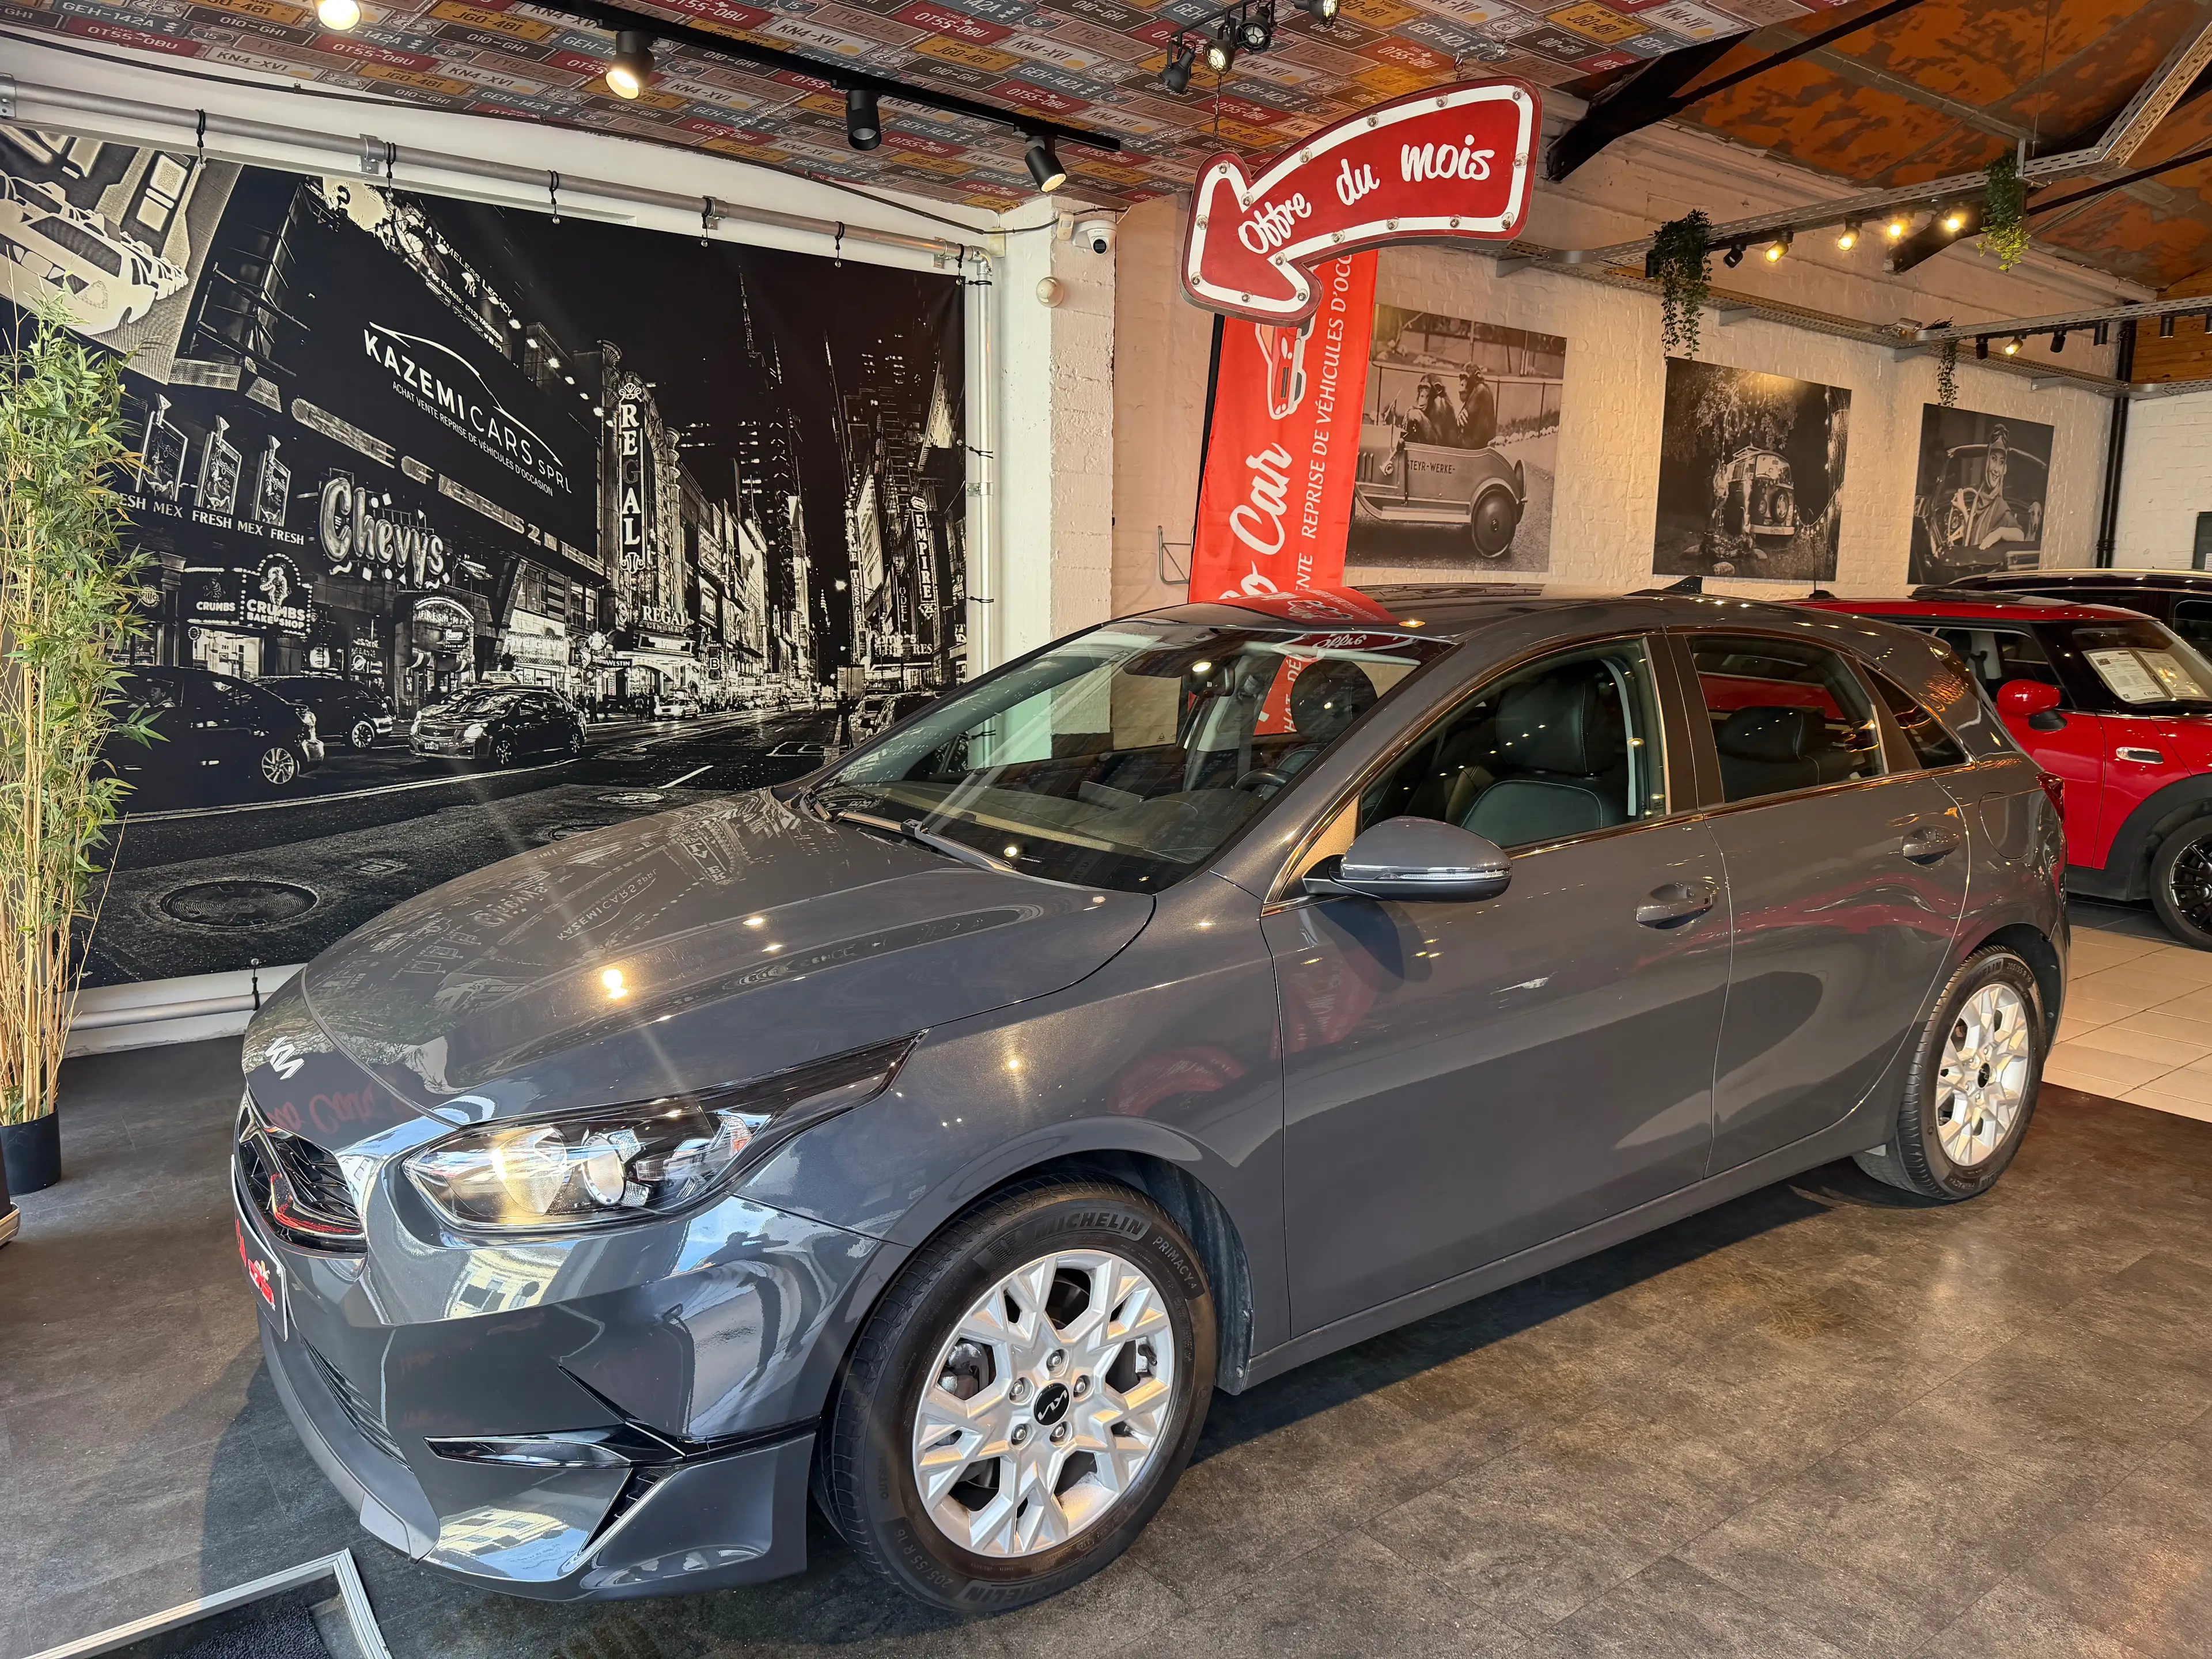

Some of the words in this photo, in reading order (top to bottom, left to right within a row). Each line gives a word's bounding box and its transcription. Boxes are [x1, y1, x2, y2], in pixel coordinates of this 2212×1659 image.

[62, 2, 154, 28] GEH-142A
[1035, 16, 1044, 26] 15
[1020, 66, 1084, 90] GEH-142A
[481, 91, 550, 111] GEH-142A
[1105, 94, 1117, 103] 15
[1309, 105, 1319, 113] 15
[1238, 192, 1312, 255] Offre
[1336, 158, 1380, 206] du
[1402, 134, 1495, 182] mois
[1315, 317, 1344, 424] VÉHICULES
[364, 329, 464, 420] KAZEMI
[471, 406, 533, 465] CARS
[539, 461, 572, 494] SPRL
[393, 381, 415, 403] ACHAT
[416, 396, 439, 419] VENTE
[440, 414, 468, 439] REPRISE
[468, 432, 478, 446] DE
[478, 436, 514, 471] VÉHICULES
[515, 464, 554, 497] D'OCCASION
[1312, 429, 1330, 456] DE
[620, 404, 641, 545] REGAL
[1229, 442, 1293, 555] Car
[1302, 460, 1325, 539] REPRISE
[153, 501, 183, 519] MEX
[192, 510, 232, 529] FRESH
[238, 520, 263, 536] MEX
[271, 528, 304, 546] FRESH
[320, 477, 444, 589] Chevys
[915, 514, 933, 599] EMPIRE
[196, 601, 236, 612] CRUMBS
[247, 599, 305, 621] CRUMBS
[642, 605, 688, 627] REGAL
[924, 605, 934, 613] 25
[247, 612, 273, 625] BAKE
[278, 619, 305, 630] SHOP
[607, 659, 630, 667] WESTIN
[1035, 1212, 1146, 1240] MICHELIN
[1153, 1236, 1194, 1282] PRIMACY
[909, 1556, 954, 1589] 205/55
